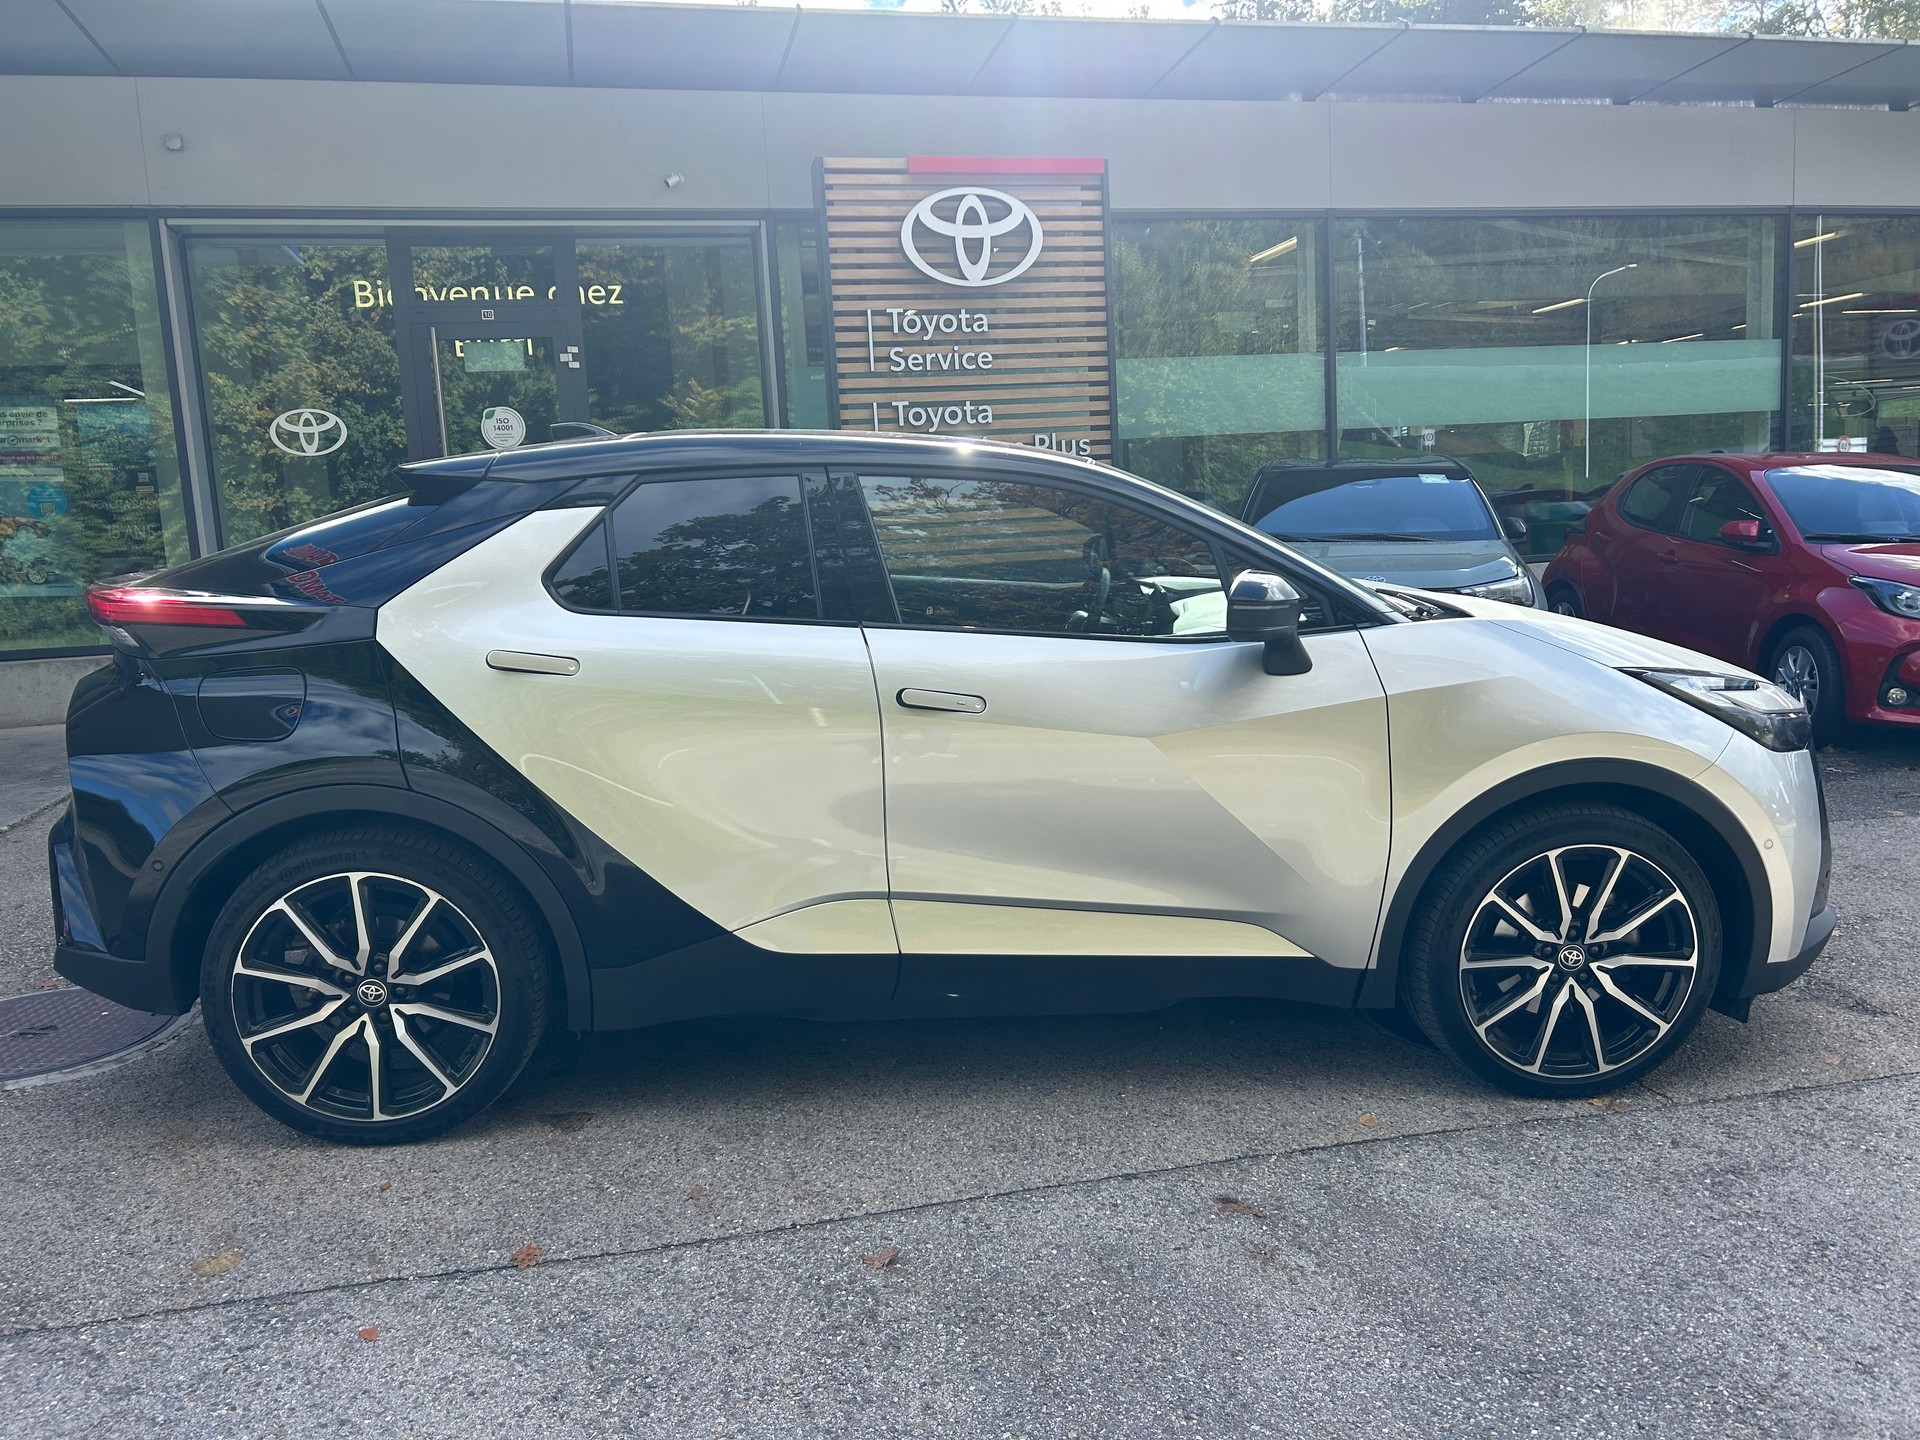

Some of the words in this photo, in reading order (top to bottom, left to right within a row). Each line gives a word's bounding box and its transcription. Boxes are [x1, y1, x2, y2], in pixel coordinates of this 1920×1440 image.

[885, 308, 989, 341] Toyota
[889, 345, 993, 372] Service
[493, 424, 514, 432] 14001
[496, 417, 510, 425] ISO
[891, 400, 993, 432] Toyota
